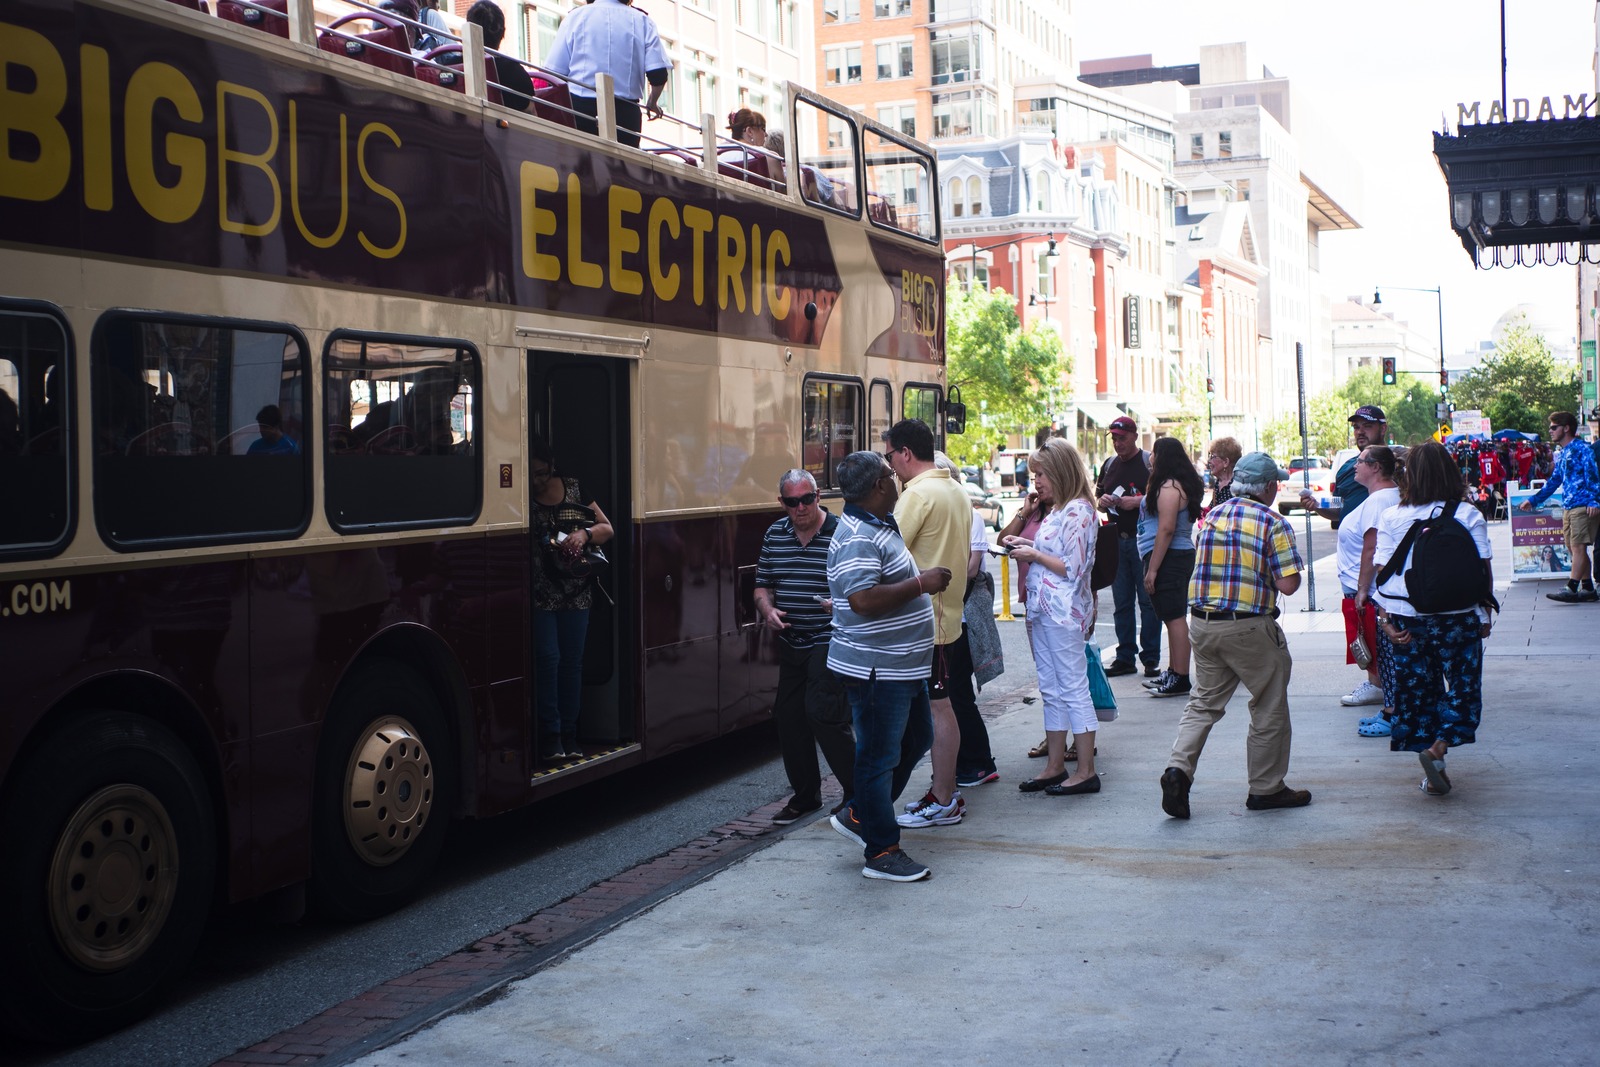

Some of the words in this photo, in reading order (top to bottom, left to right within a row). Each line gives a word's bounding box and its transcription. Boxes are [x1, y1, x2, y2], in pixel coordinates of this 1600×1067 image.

[1457, 93, 1600, 126] MADAM
[519, 160, 791, 321] ELECTRIC
[902, 269, 921, 304] BIG
[902, 303, 922, 336] BUS
[1130, 298, 1138, 342] PARKING
[1485, 462, 1492, 475] 8
[2, 580, 71, 617] .COM
